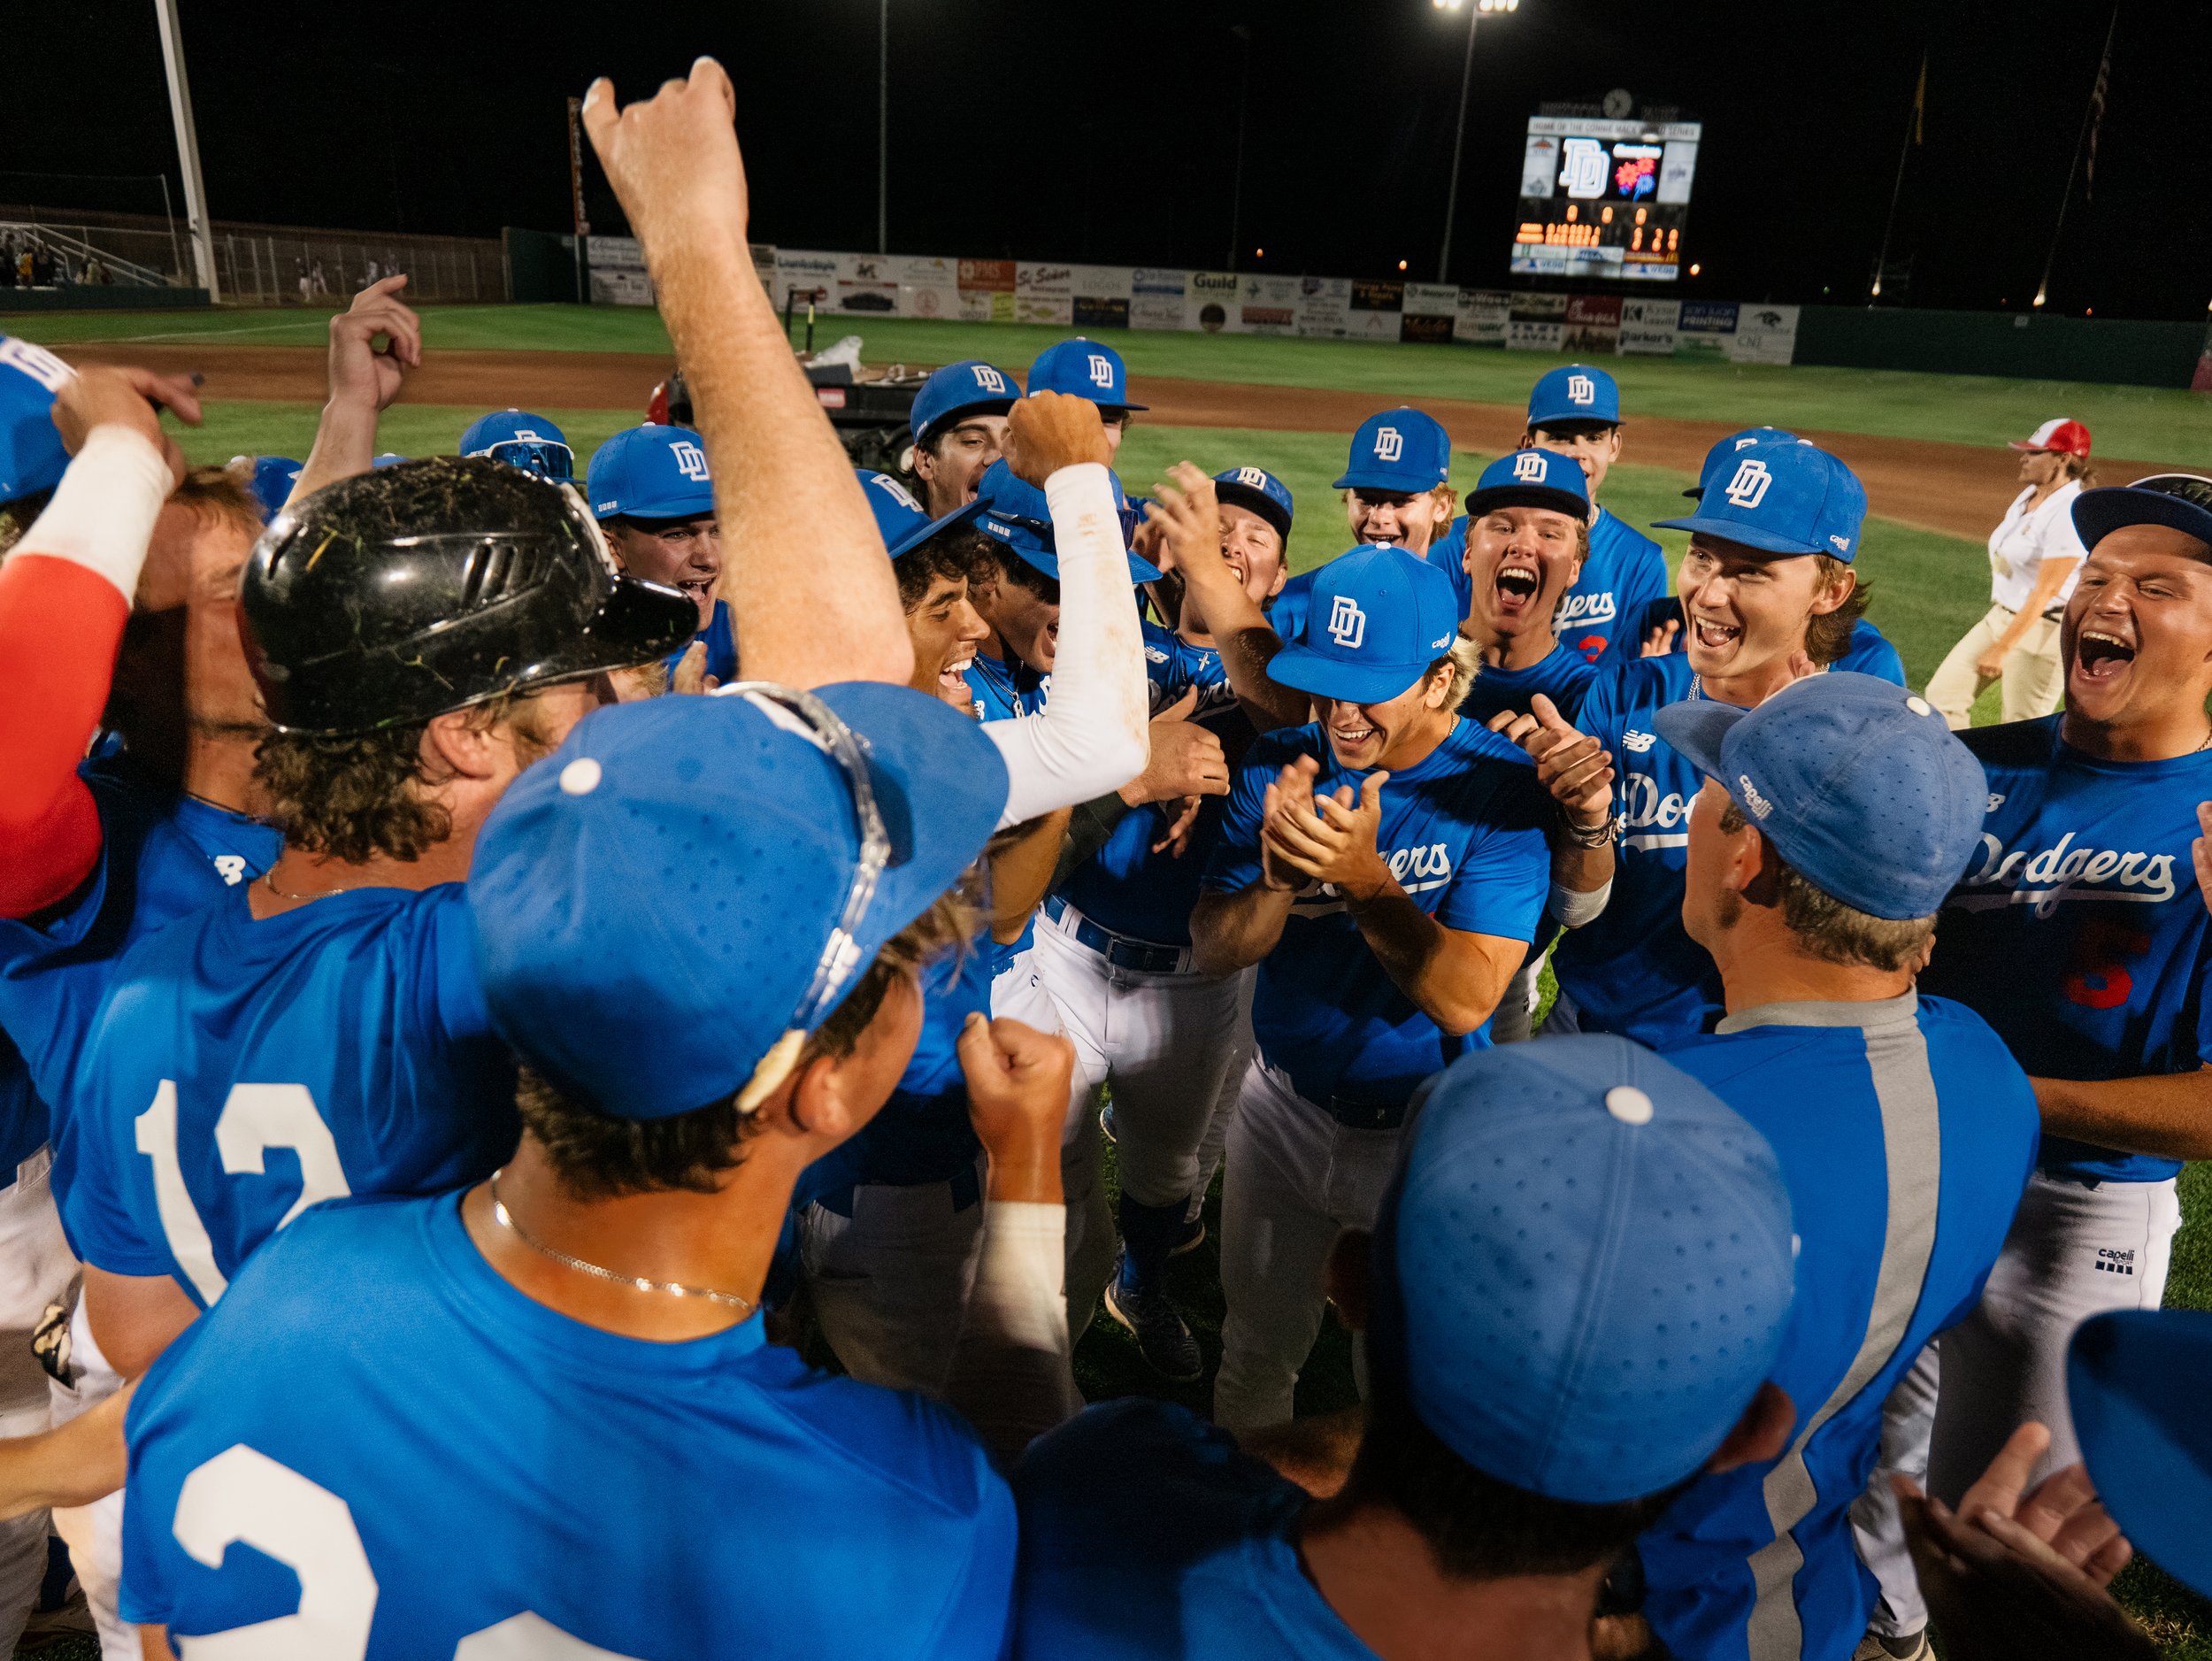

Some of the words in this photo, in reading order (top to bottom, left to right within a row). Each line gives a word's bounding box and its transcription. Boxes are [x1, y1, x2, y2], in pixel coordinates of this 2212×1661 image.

[1194, 273, 1237, 289] Guild
[971, 365, 1006, 393] DD
[1087, 354, 1113, 388] DD
[1568, 374, 1594, 404] DD
[1373, 427, 1403, 461] DD
[669, 441, 710, 481] DD
[1513, 452, 1548, 482] DD
[1236, 466, 1267, 490] DD
[1725, 459, 1772, 509] DD
[1328, 595, 1365, 649] DD
[1961, 832, 2177, 920] Dodgers
[2098, 1248, 2135, 1261] capelli
